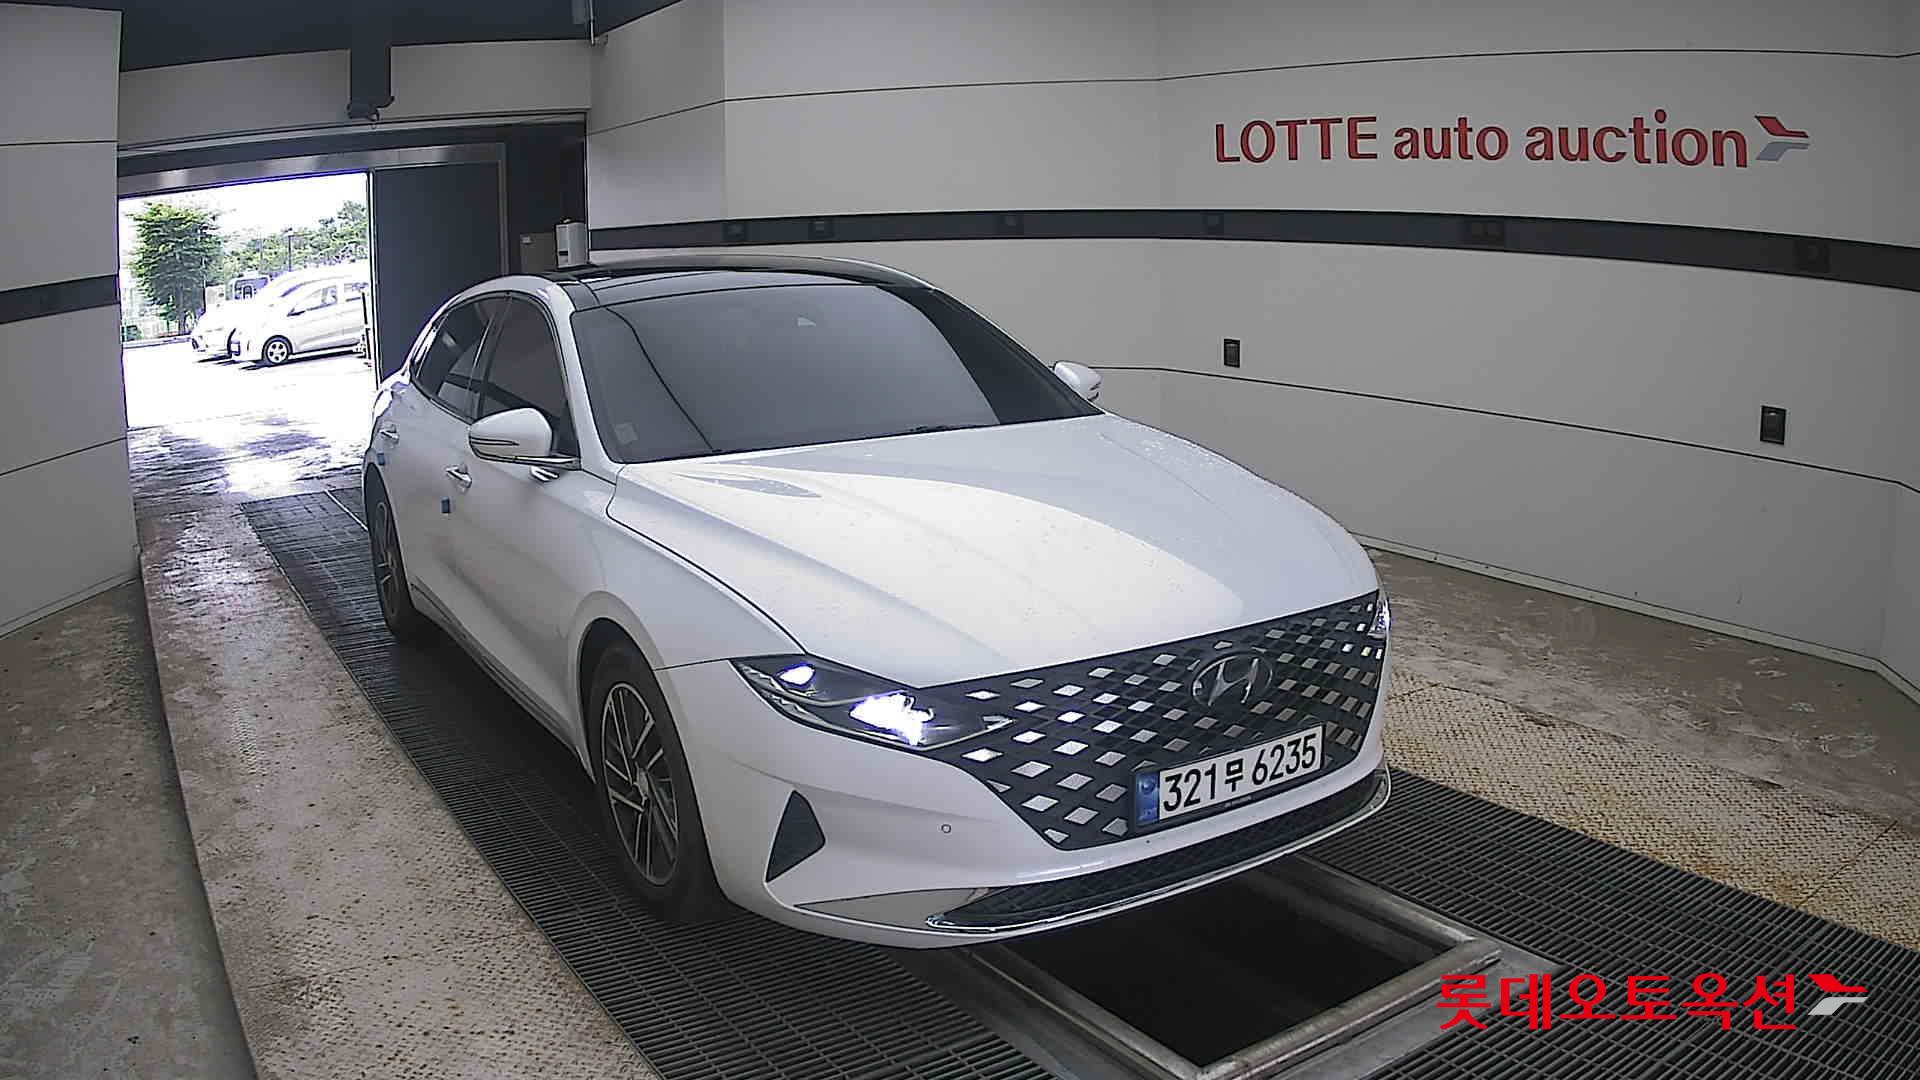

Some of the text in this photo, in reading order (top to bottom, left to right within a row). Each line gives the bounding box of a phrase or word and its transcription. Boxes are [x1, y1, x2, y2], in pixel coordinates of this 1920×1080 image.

[1215, 109, 1748, 168] LOTTE auto auction
